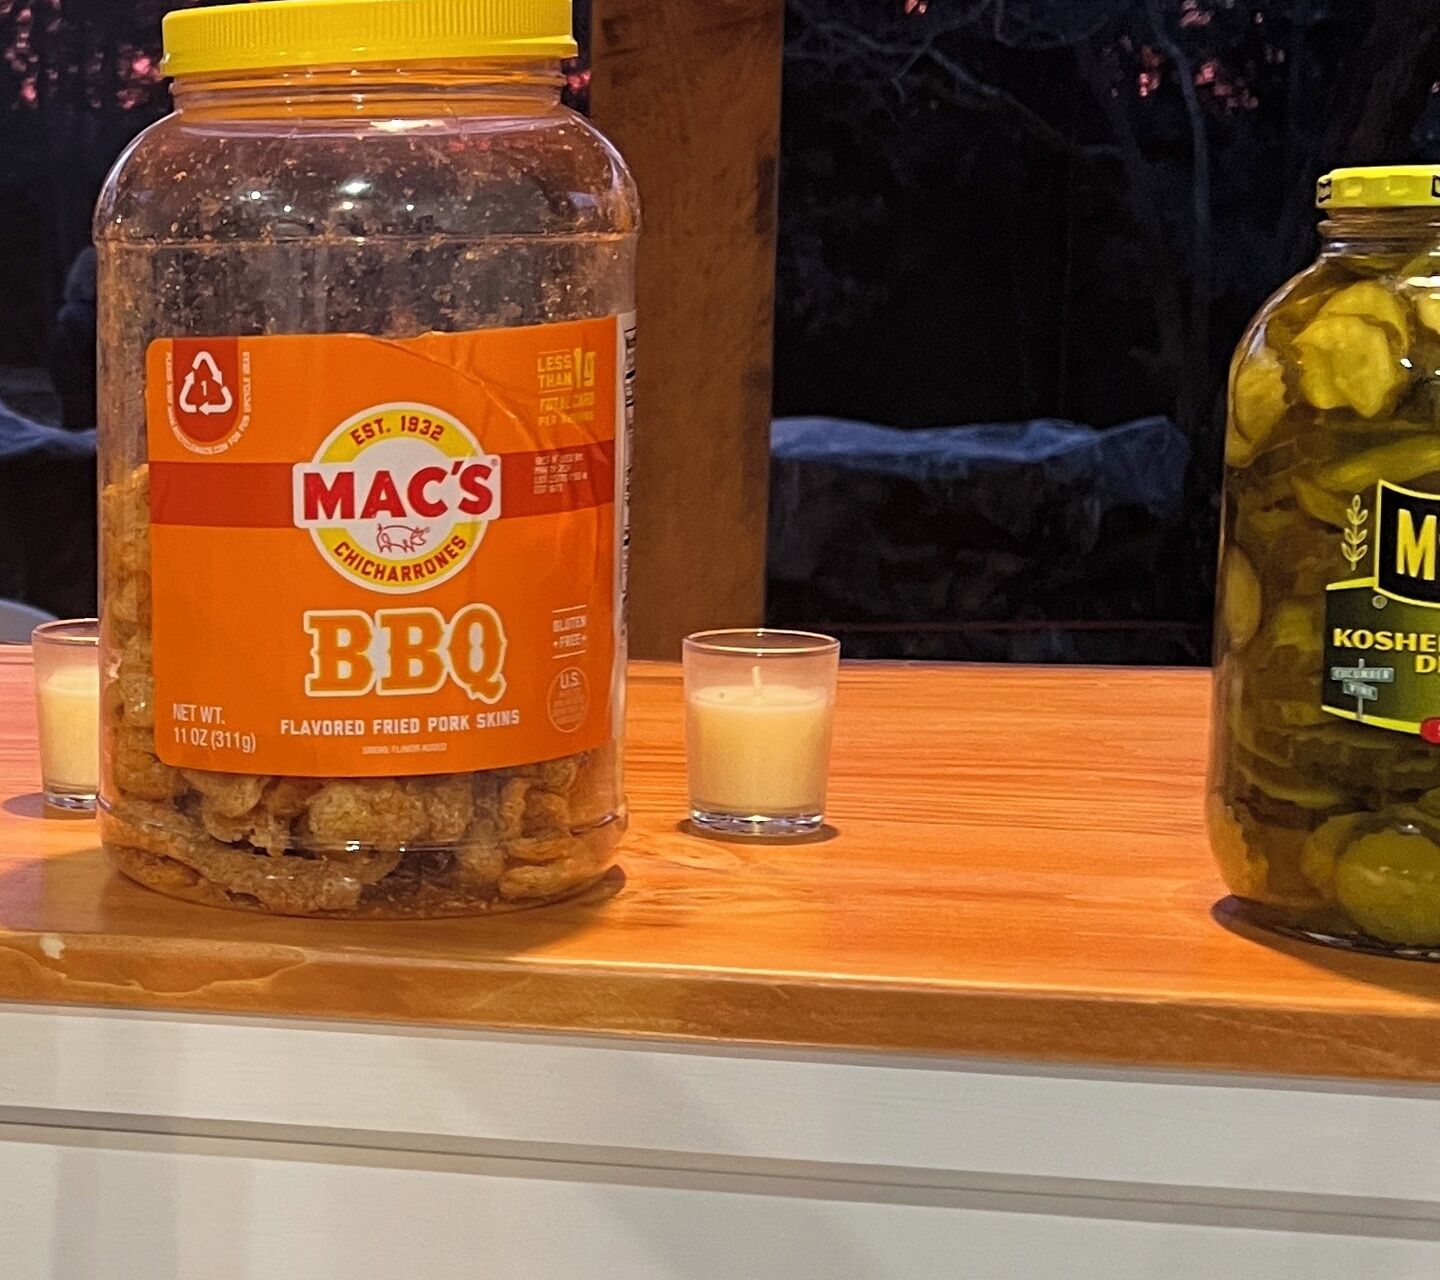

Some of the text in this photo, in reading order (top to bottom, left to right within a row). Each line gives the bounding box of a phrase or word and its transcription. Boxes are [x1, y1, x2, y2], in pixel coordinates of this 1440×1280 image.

[537, 354, 572, 373] LESS
[574, 347, 597, 388] 1g
[201, 380, 207, 396] 1
[538, 372, 572, 389] THAN
[350, 415, 445, 446] EST. 1932
[303, 460, 494, 521] MAC'S
[334, 535, 467, 582] CHICHARRONES
[1333, 628, 1440, 652] KOSHE
[304, 603, 508, 705] BBQ
[172, 703, 226, 725] NET WT.
[280, 709, 520, 736] FLAVORED FRIED PORK SKINS
[174, 726, 257, 754] 11 OZ (311g)
